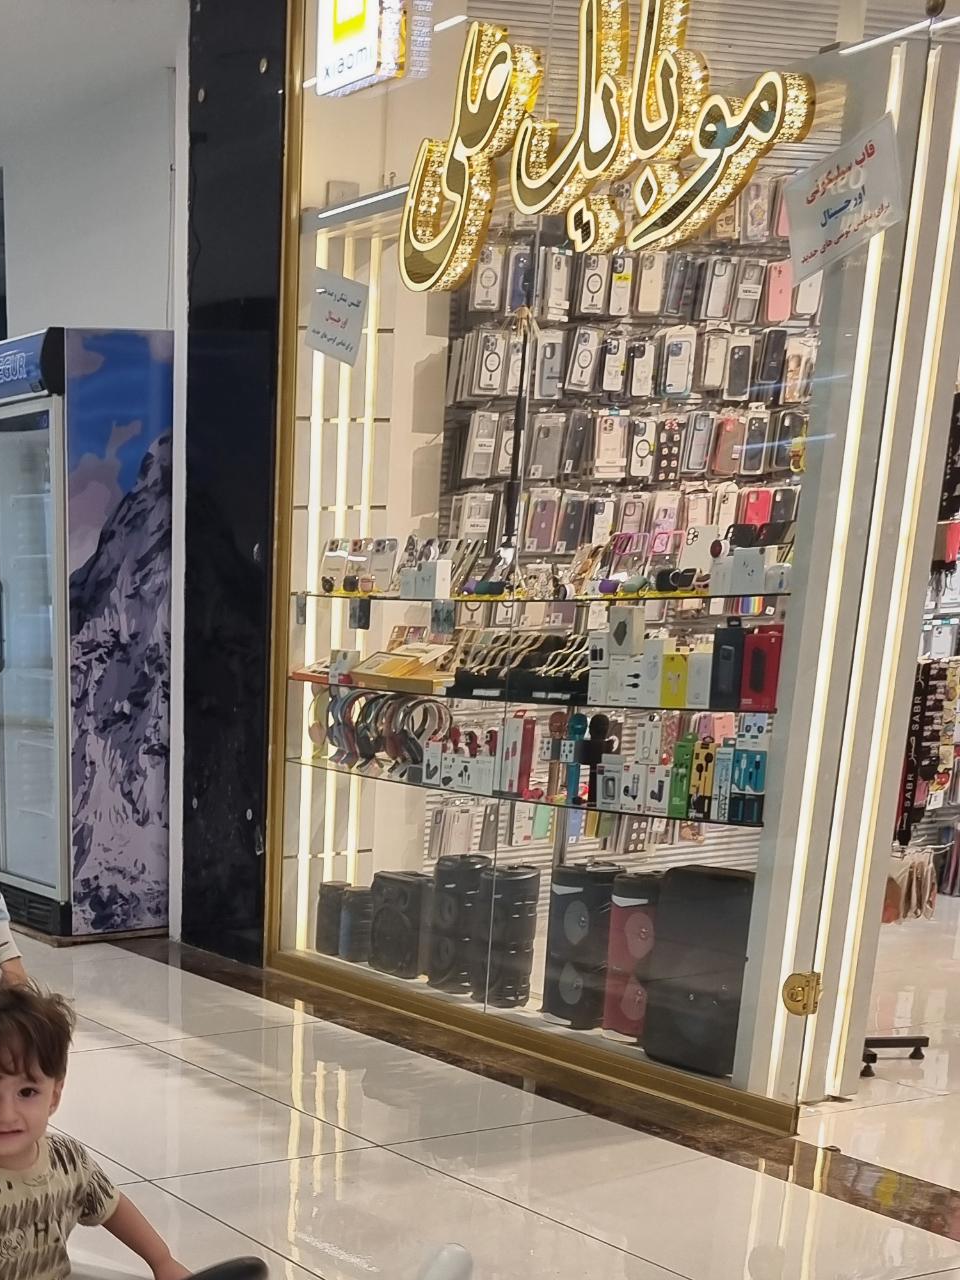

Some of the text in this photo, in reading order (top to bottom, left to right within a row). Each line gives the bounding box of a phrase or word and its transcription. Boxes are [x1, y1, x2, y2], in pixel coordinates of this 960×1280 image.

[400, 21, 514, 292] علی
[912, 696, 922, 731] SABR
[904, 773, 915, 808] SABR
